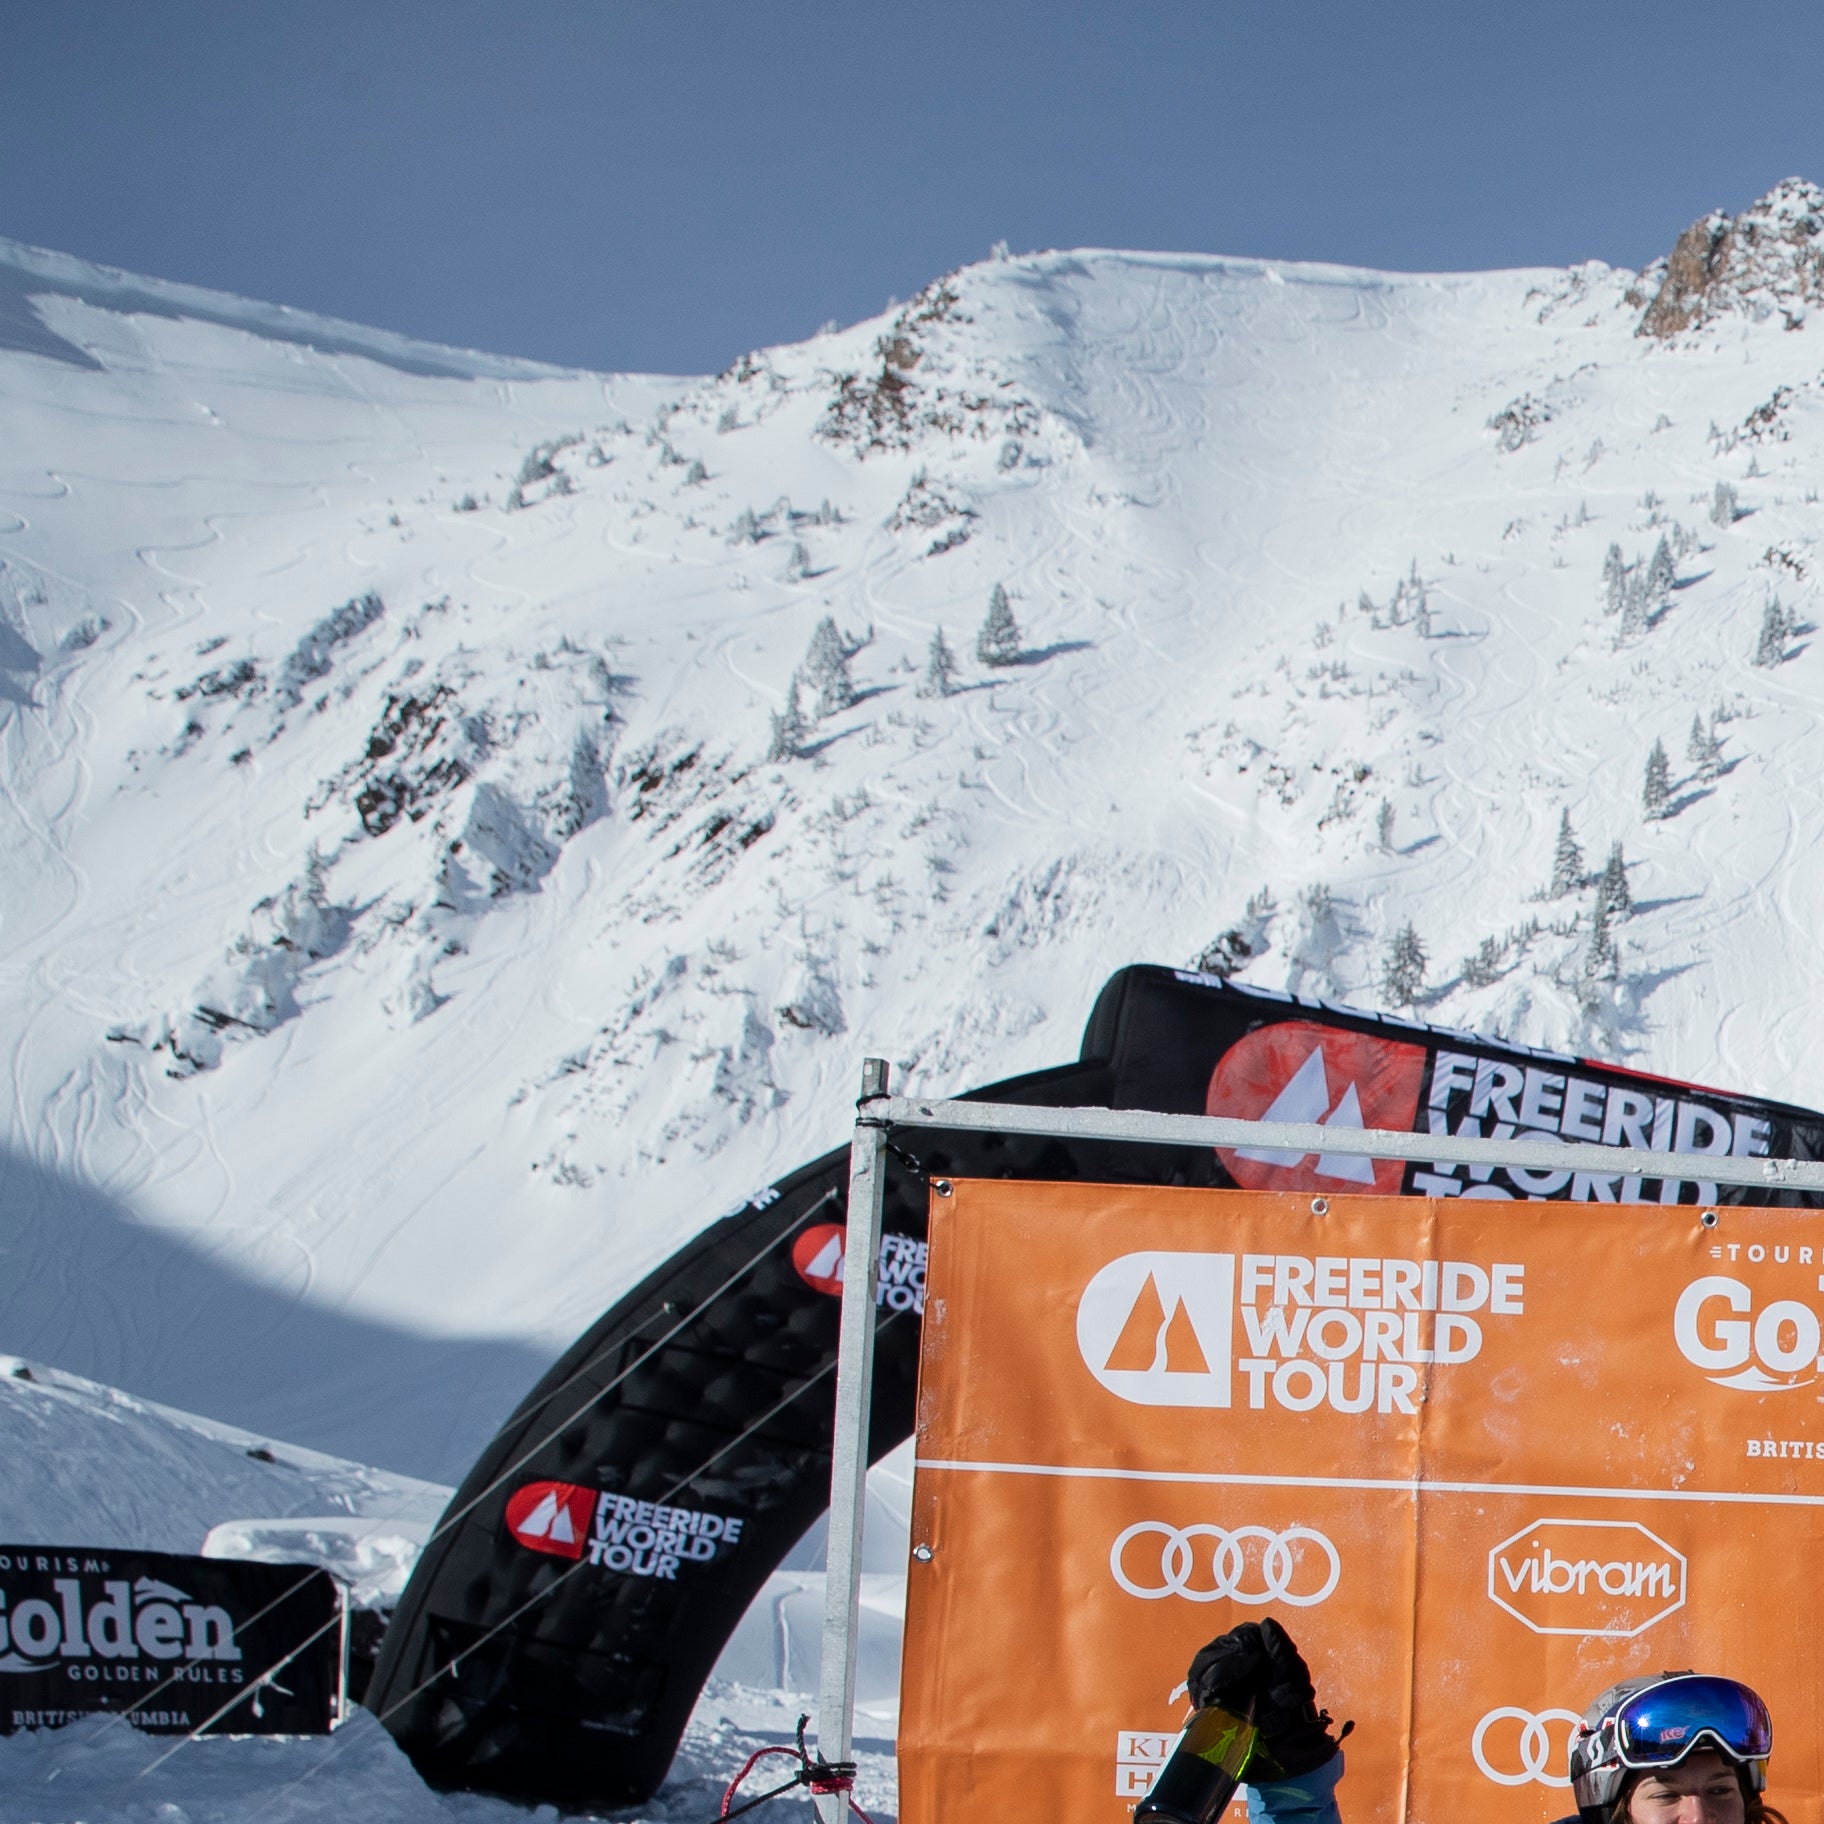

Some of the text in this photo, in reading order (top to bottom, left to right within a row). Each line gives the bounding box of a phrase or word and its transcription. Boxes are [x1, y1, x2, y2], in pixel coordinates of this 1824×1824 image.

[1430, 1049, 1772, 1157] FREERIDE
[1242, 1254, 1524, 1314] FREERIDE
[1240, 1305, 1482, 1364] WORLD
[1239, 1358, 1417, 1414] TOUR
[595, 1516, 717, 1562] WORLD
[597, 1491, 744, 1545] FREERIDE
[587, 1538, 681, 1581] TOUR
[1500, 1540, 1676, 1599] vibram
[0, 1578, 242, 1662] olden
[68, 1665, 244, 1683] GOLDEN RULES
